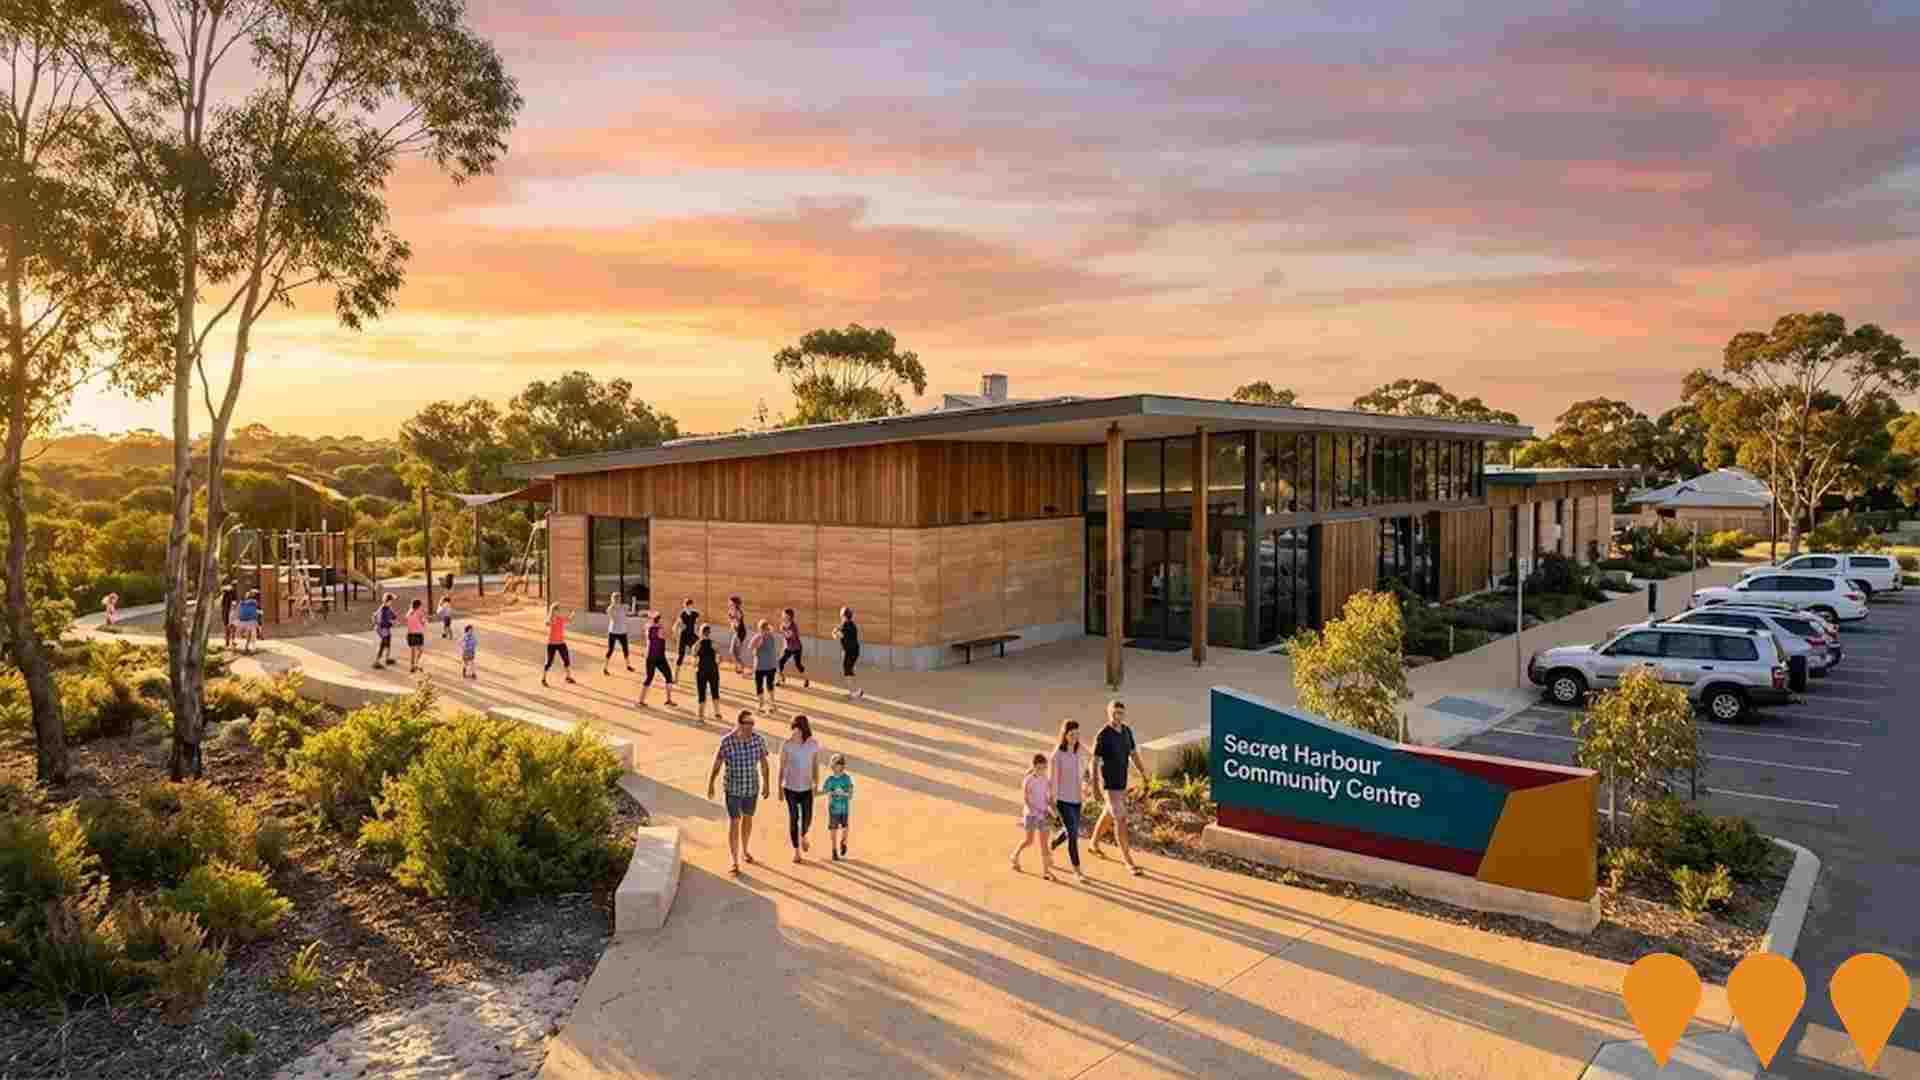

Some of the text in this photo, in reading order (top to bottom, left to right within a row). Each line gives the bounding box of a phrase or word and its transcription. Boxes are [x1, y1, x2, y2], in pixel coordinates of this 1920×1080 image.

[1224, 734, 1381, 775] Secret Harbour
[1224, 759, 1421, 808] Community Centre
